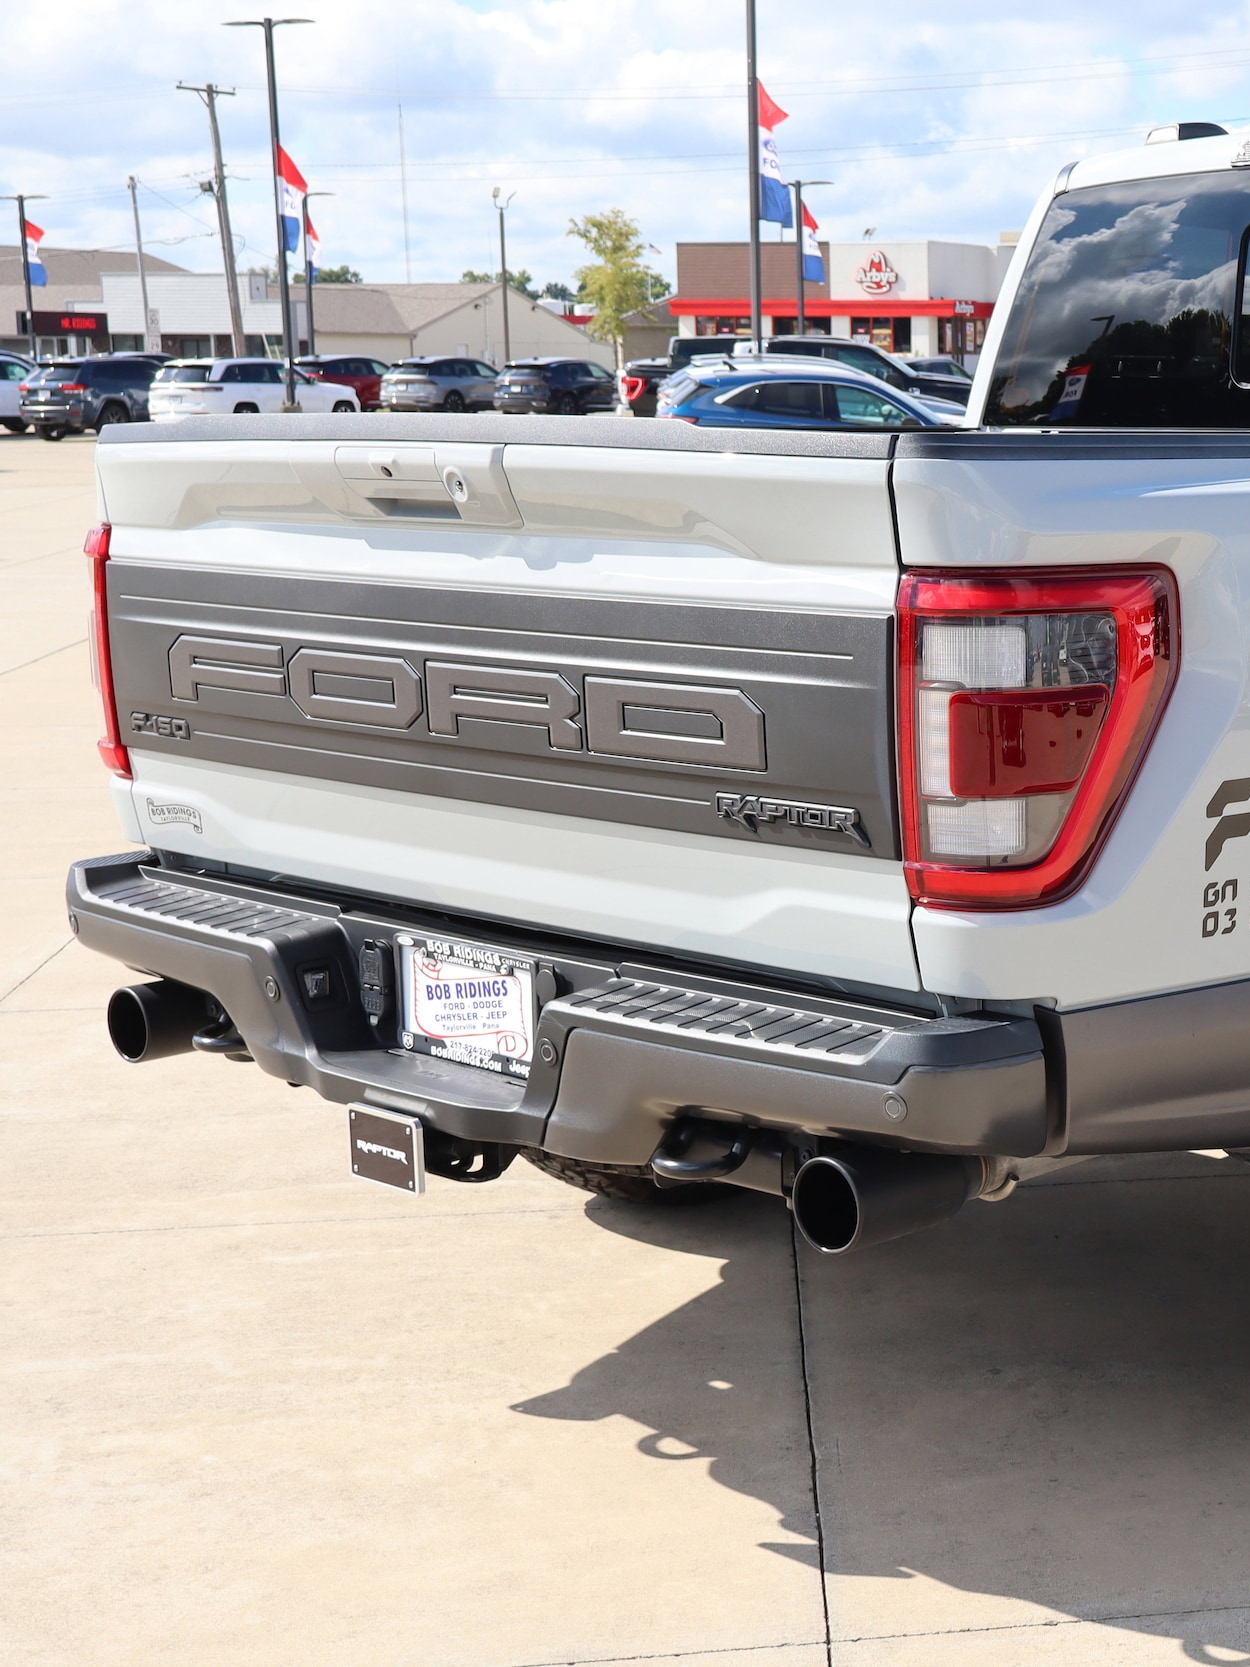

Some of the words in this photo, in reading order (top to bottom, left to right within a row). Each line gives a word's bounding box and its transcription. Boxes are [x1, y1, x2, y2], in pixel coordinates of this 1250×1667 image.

[858, 267, 897, 286] Arby's
[167, 633, 769, 773] FORD
[151, 807, 166, 817] BOB
[167, 807, 197, 819] RIDINGS
[715, 791, 872, 848] RAPTOR
[426, 940, 450, 955] BOB
[453, 945, 501, 966] RIDINGS
[433, 953, 474, 968] TAYLORVILLE
[479, 962, 497, 973] PANA
[501, 958, 530, 970] CHRYSLER
[426, 984, 451, 1001] BOB
[456, 980, 508, 999] RIDINGS
[443, 1002, 466, 1011] FORD
[473, 1000, 503, 1009] DODGE
[435, 1012, 478, 1022] CHRYSLER
[486, 1011, 507, 1020] JEEP
[356, 1139, 409, 1165] RAPTOR
